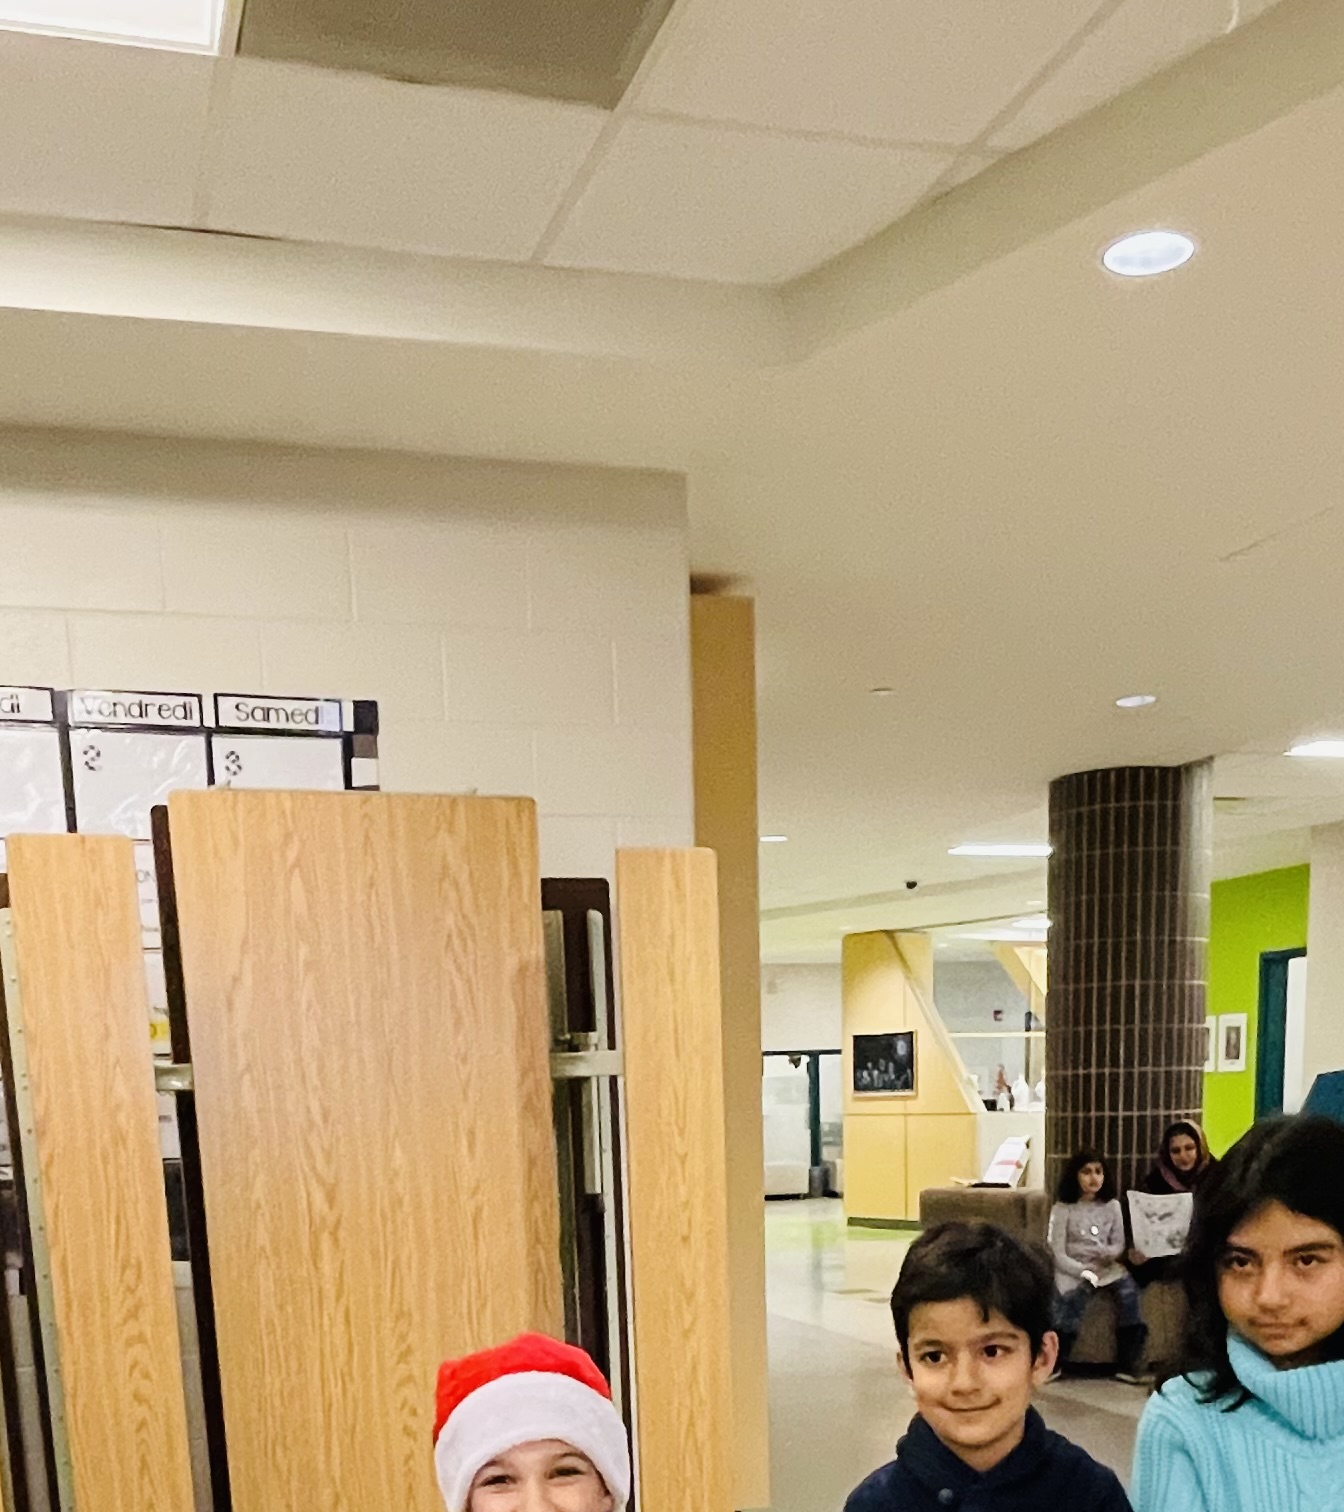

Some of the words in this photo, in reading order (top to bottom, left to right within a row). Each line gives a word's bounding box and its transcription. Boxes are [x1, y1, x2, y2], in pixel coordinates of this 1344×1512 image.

[79, 696, 193, 721] Vendredi
[82, 744, 102, 771] 2
[224, 750, 243, 776] 3
